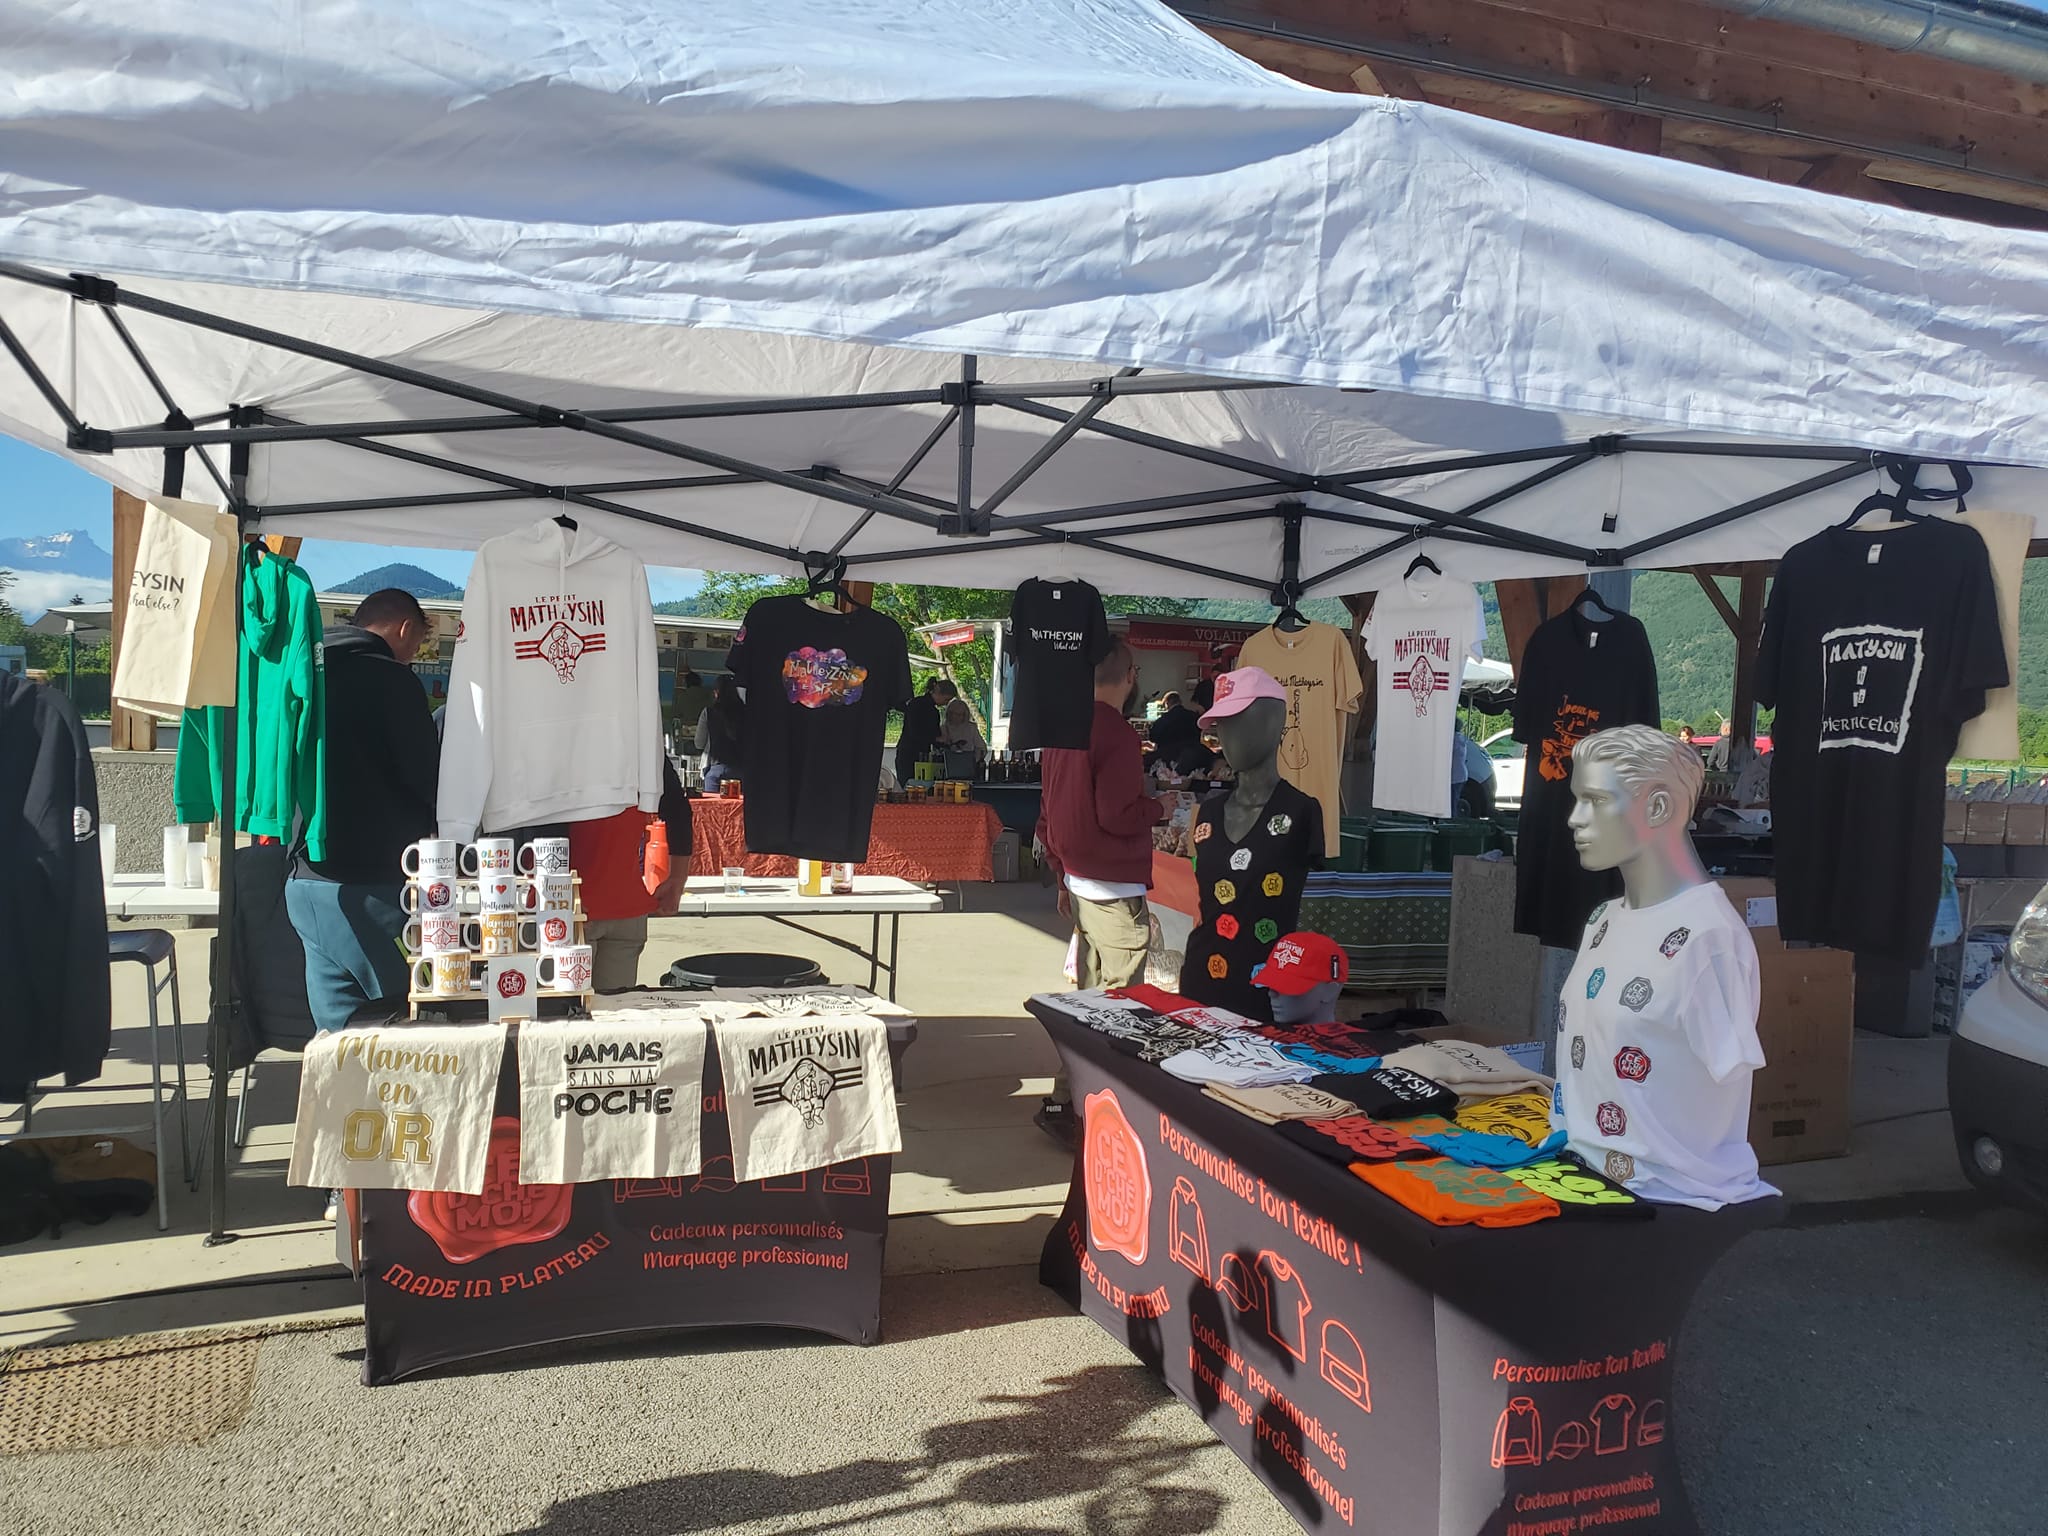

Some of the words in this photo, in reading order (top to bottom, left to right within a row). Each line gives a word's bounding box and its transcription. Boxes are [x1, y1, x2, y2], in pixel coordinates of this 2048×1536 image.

[130, 593, 151, 608] hat
[153, 596, 180, 611] else?
[1394, 638, 1451, 662] MATHEYSINE
[1830, 639, 1906, 664] MATYSIN
[777, 1030, 791, 1040] LE
[792, 1025, 825, 1038] PETIT
[336, 1034, 465, 1076] Maman
[563, 1041, 663, 1065] JAMAIS
[378, 1080, 417, 1105] en
[569, 1069, 615, 1087] SANS
[629, 1068, 654, 1084] MA
[554, 1088, 673, 1119] POCHE
[341, 1109, 434, 1165] OR
[1257, 1178, 1288, 1228] ton
[650, 1223, 726, 1242] Cadeaux
[733, 1220, 844, 1241] personnalisés
[381, 1263, 459, 1298] MADE
[463, 1280, 493, 1298] IN
[499, 1232, 612, 1294] PLATEAU
[643, 1250, 737, 1271] Marquage
[742, 1246, 849, 1270] professionnel
[1068, 1220, 1096, 1284] MADE
[1097, 1271, 1111, 1301] IN
[1113, 1285, 1172, 1319] PLATEAU
[1493, 1356, 1601, 1383] Personnalise
[1606, 1354, 1629, 1376] ton
[1192, 1313, 1244, 1377] Cadeaux
[1248, 1365, 1347, 1471] personnalisés
[1189, 1345, 1253, 1427] Marquage
[1256, 1414, 1354, 1527] professionnel
[1514, 1491, 1569, 1513] Cadeaux
[1573, 1472, 1655, 1507] personnalisés
[1580, 1498, 1661, 1532] professionnel
